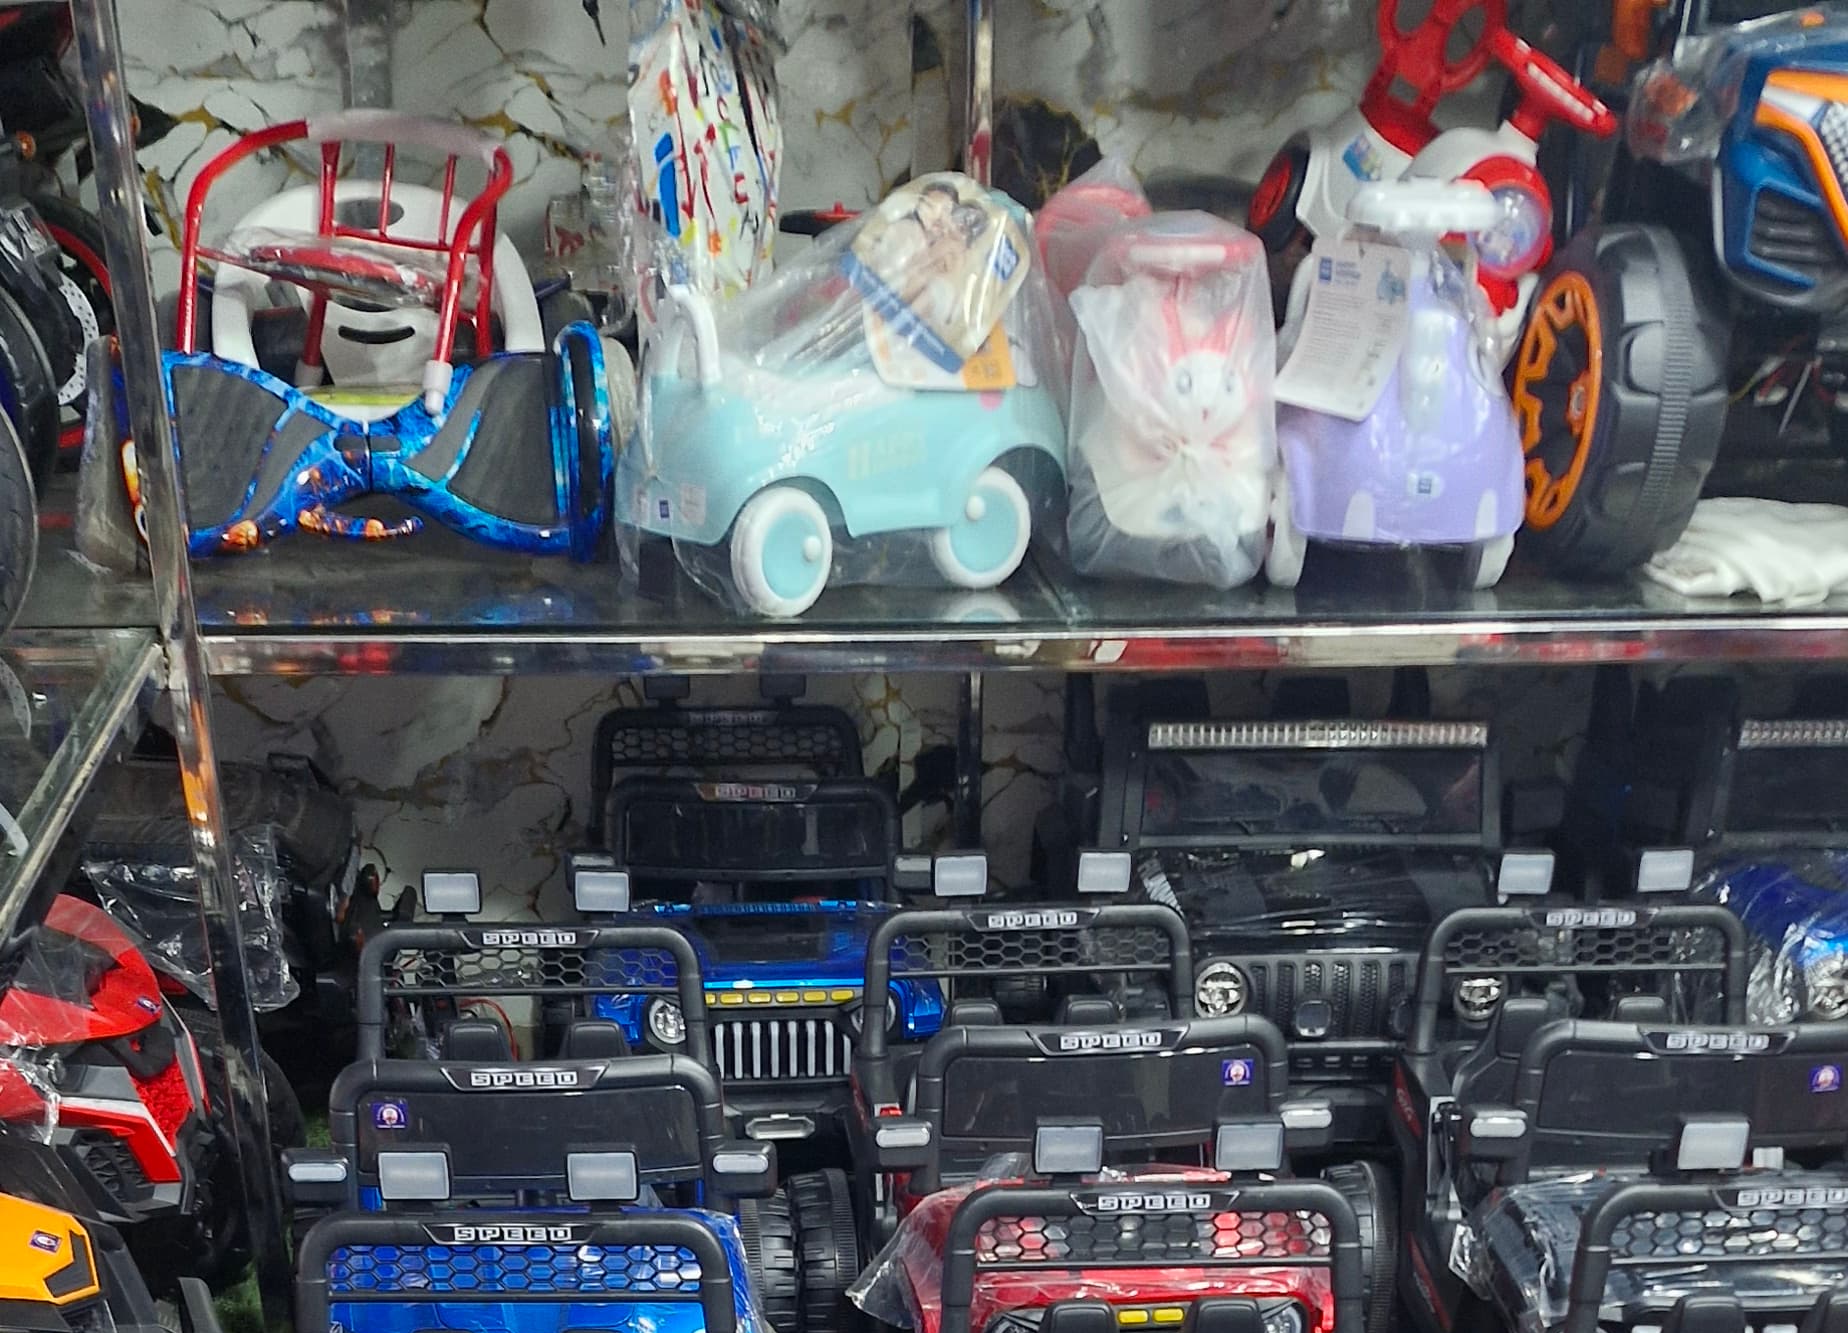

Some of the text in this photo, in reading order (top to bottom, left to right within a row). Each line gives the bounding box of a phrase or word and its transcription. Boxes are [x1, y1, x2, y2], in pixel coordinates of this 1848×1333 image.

[988, 911, 1077, 928] SPEED
[1546, 910, 1636, 927] SPEED
[482, 932, 577, 945] SPEED
[1060, 1031, 1162, 1050] SPEED
[1667, 1034, 1770, 1050] SPEED
[471, 1071, 578, 1087] SPEED
[1098, 1194, 1211, 1210] SPEED
[454, 1226, 572, 1241] SPEED
